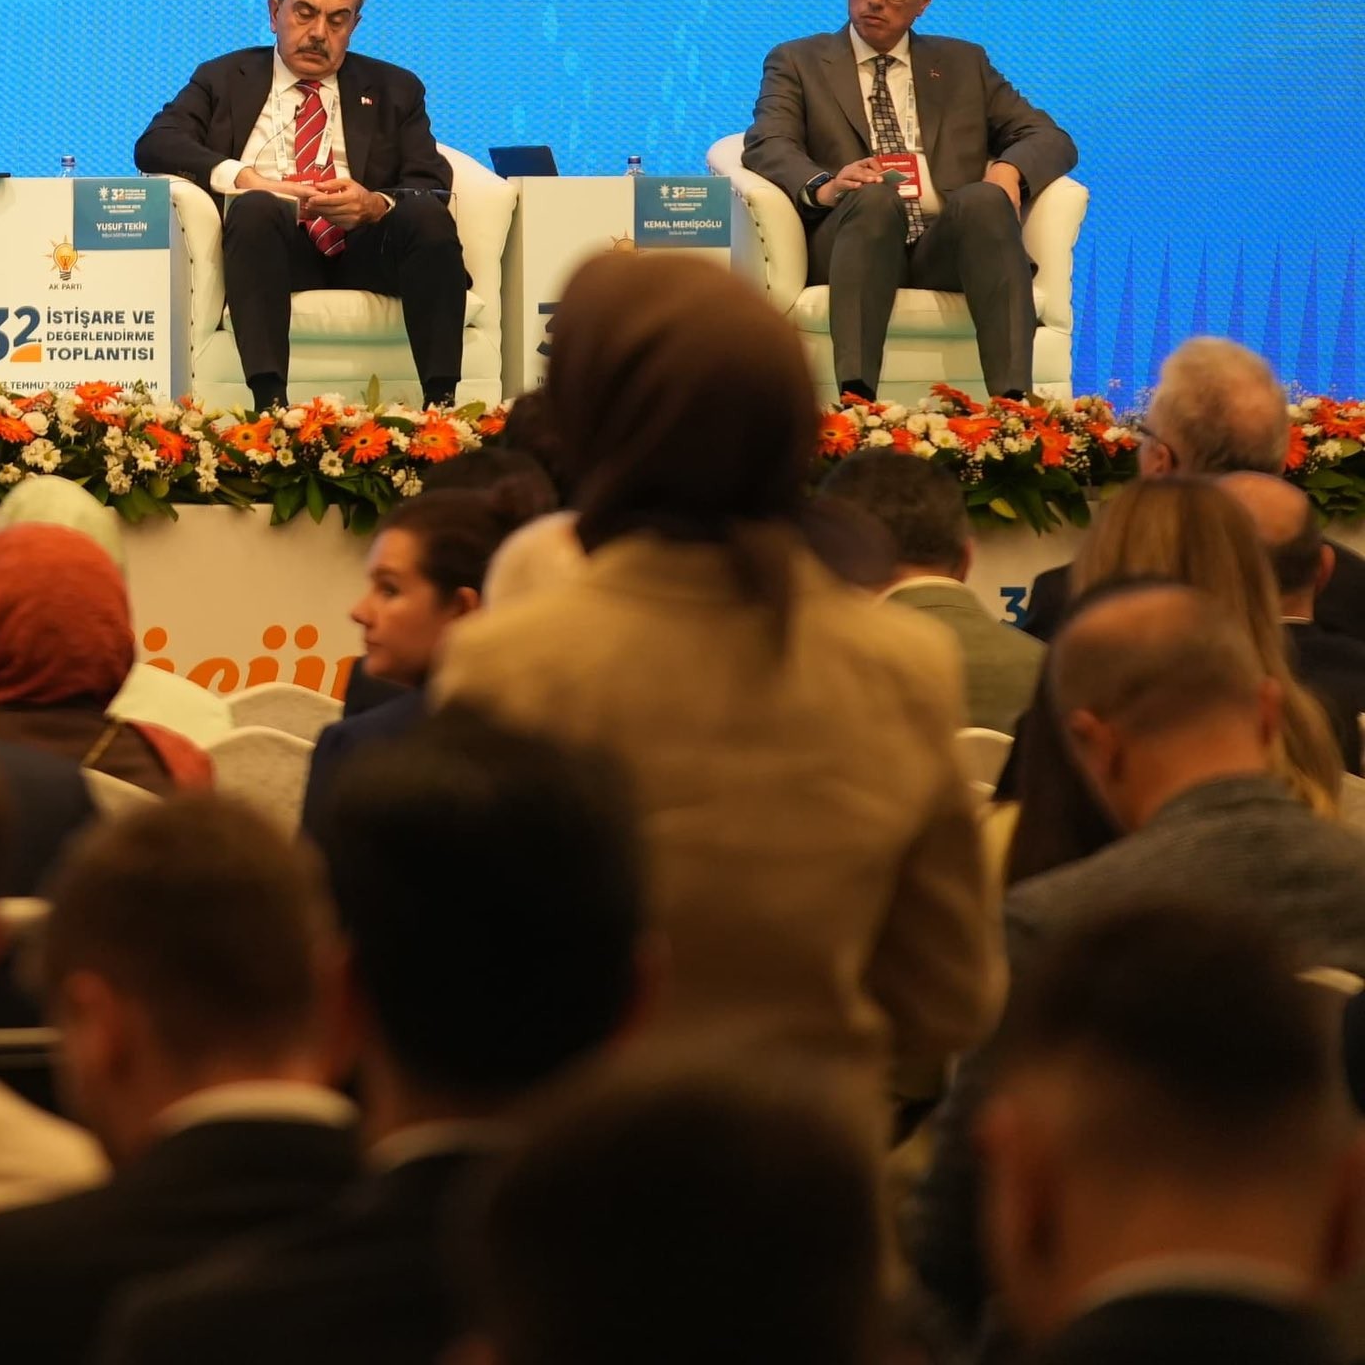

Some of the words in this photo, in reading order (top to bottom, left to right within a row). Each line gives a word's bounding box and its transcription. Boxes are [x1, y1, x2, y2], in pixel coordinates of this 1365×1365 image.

[96, 222, 122, 232] YUSUF
[124, 221, 148, 232] TEKİN
[644, 220, 671, 228] KEMAL
[47, 306, 125, 329] İSTİŞARE
[132, 310, 155, 324] VE
[47, 347, 154, 361] TOPLANTISI
